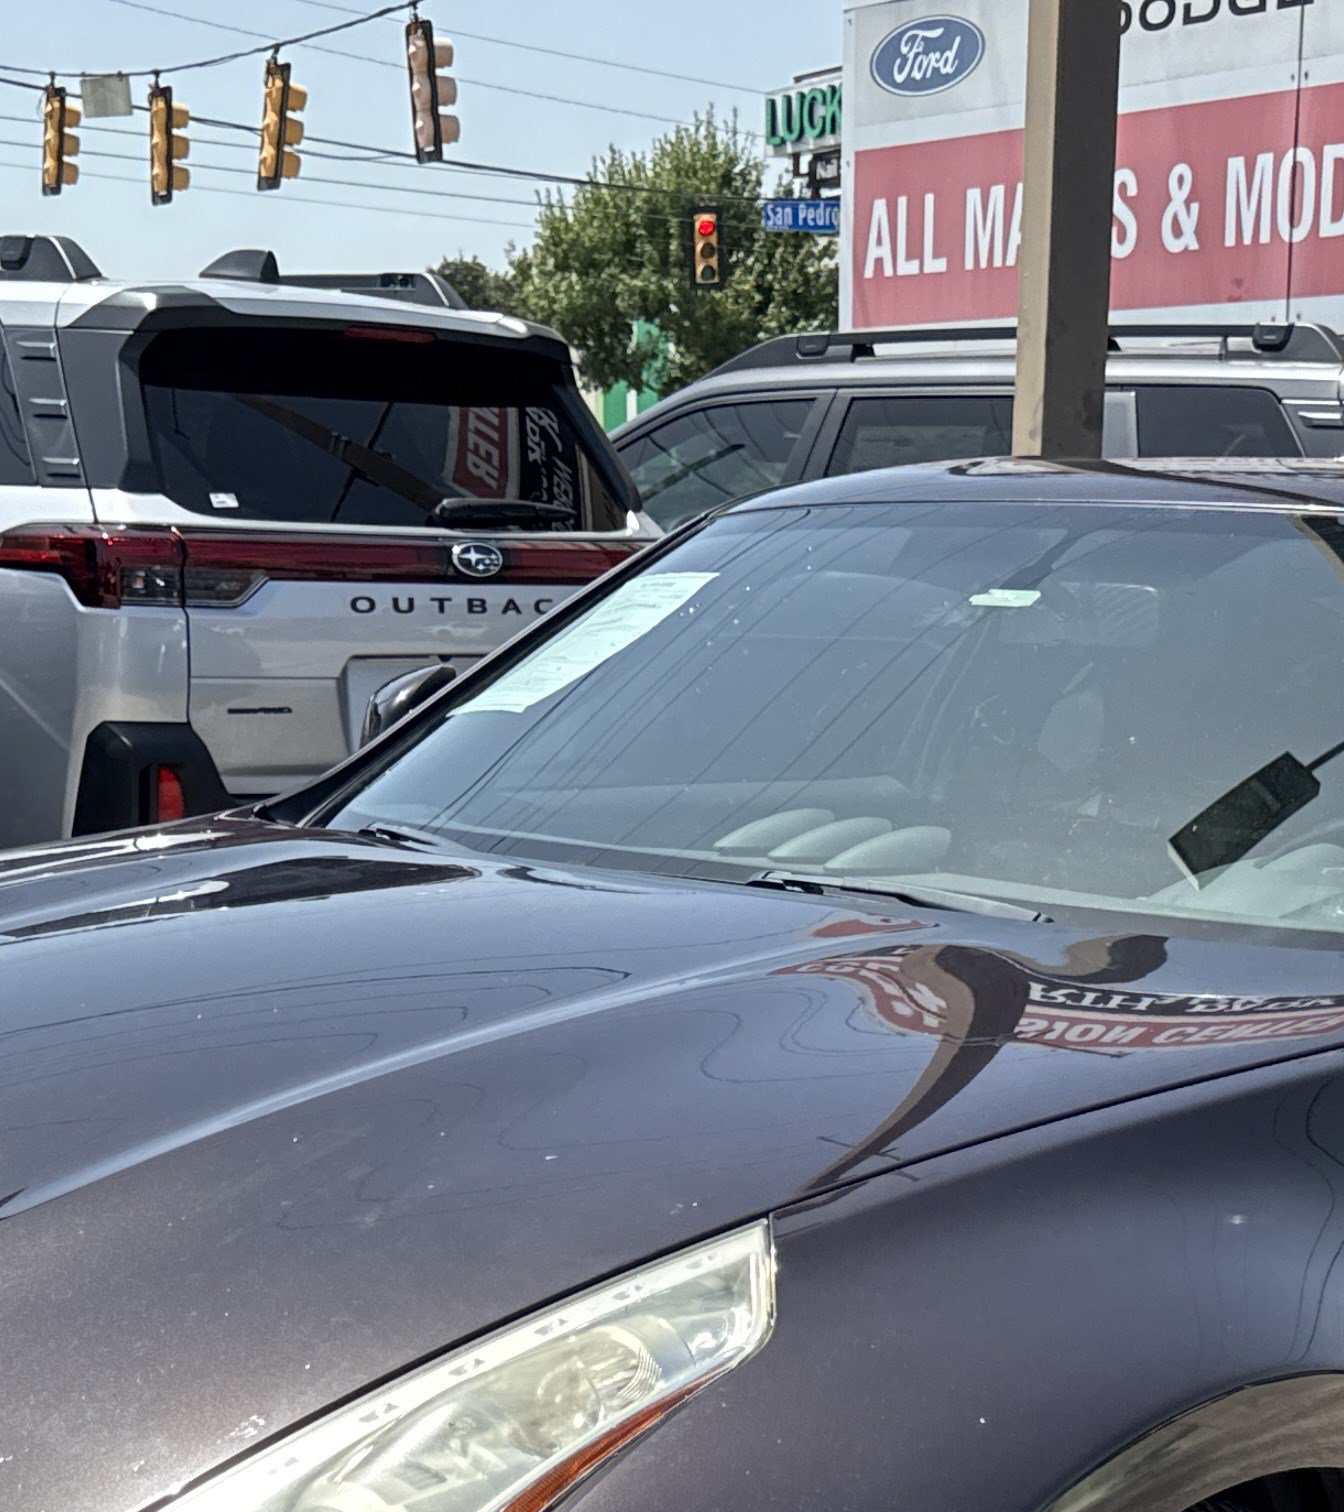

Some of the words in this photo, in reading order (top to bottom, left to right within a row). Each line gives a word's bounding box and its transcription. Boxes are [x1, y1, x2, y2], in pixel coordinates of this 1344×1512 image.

[893, 27, 961, 84] Ford
[766, 204, 793, 226] San
[863, 192, 947, 279] ALL
[1161, 163, 1199, 253] &
[350, 596, 554, 615] OUTBAC
